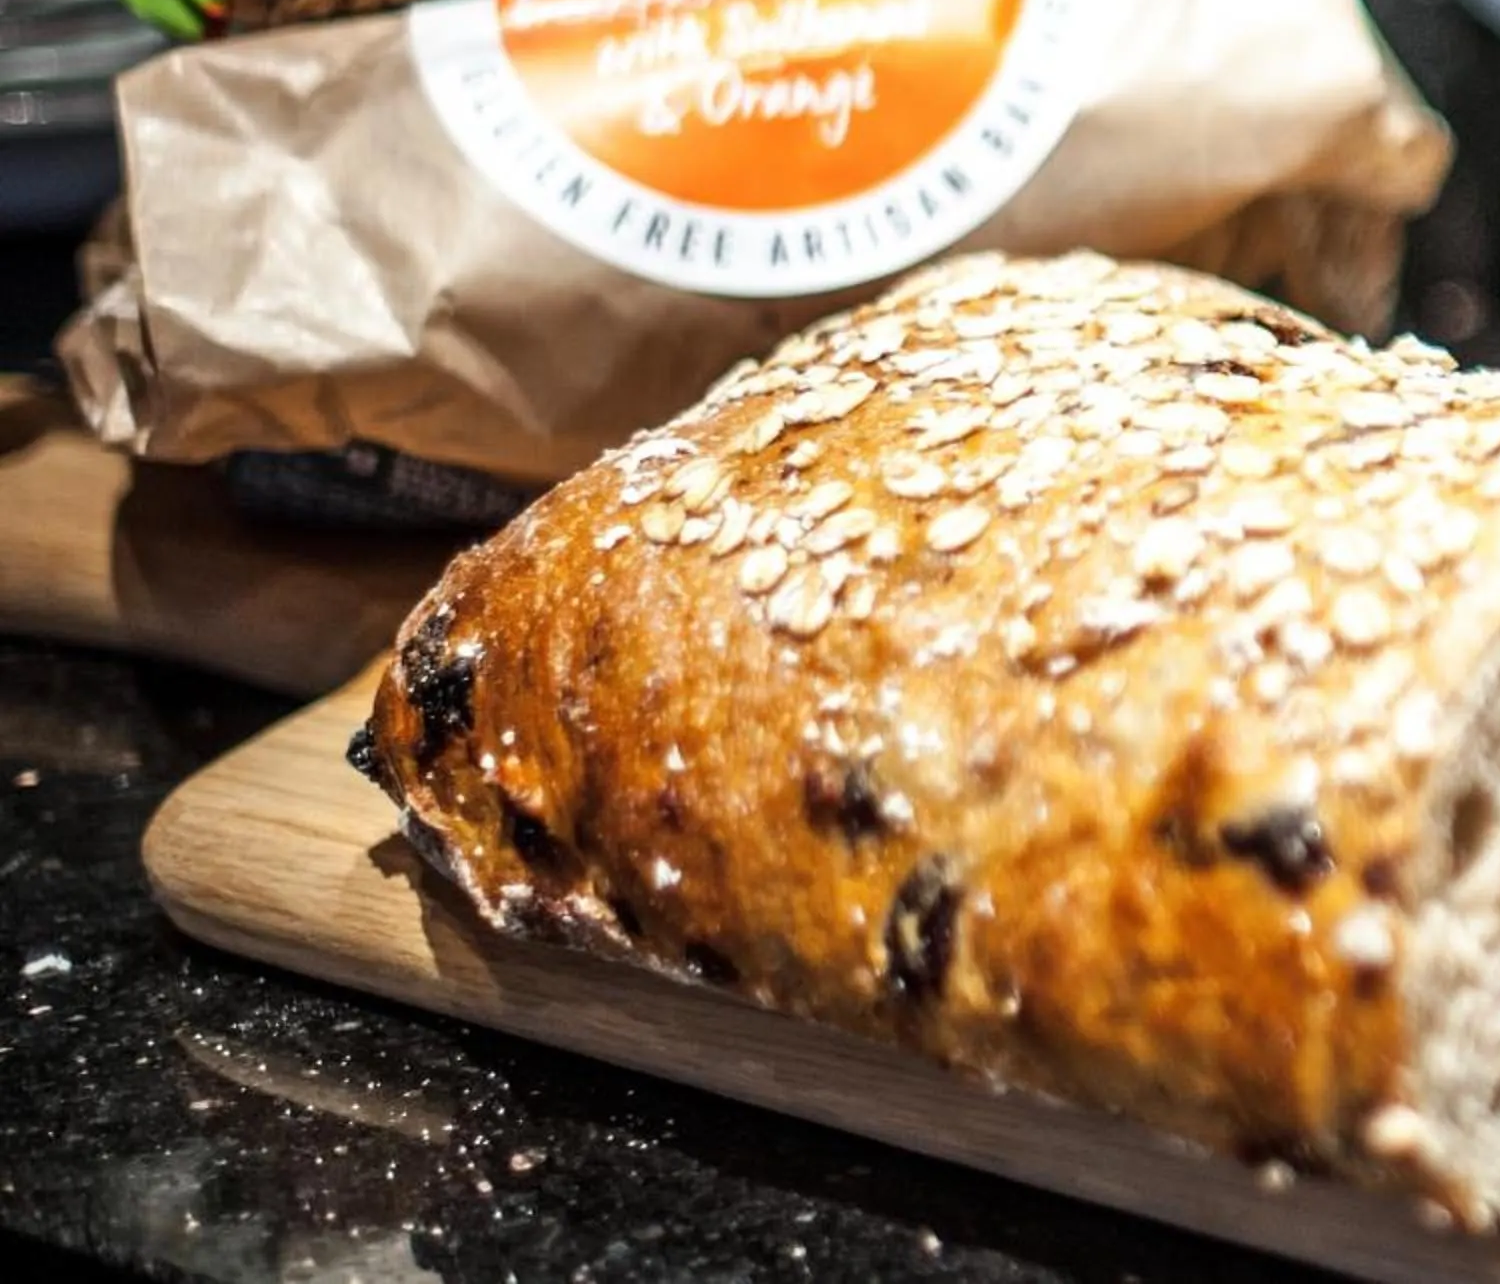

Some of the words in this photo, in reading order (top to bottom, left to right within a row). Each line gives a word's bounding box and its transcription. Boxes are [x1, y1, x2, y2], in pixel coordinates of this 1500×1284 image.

[701, 59, 877, 148] Orange
[610, 198, 728, 265] FREE
[770, 167, 971, 267] ARTISAN
